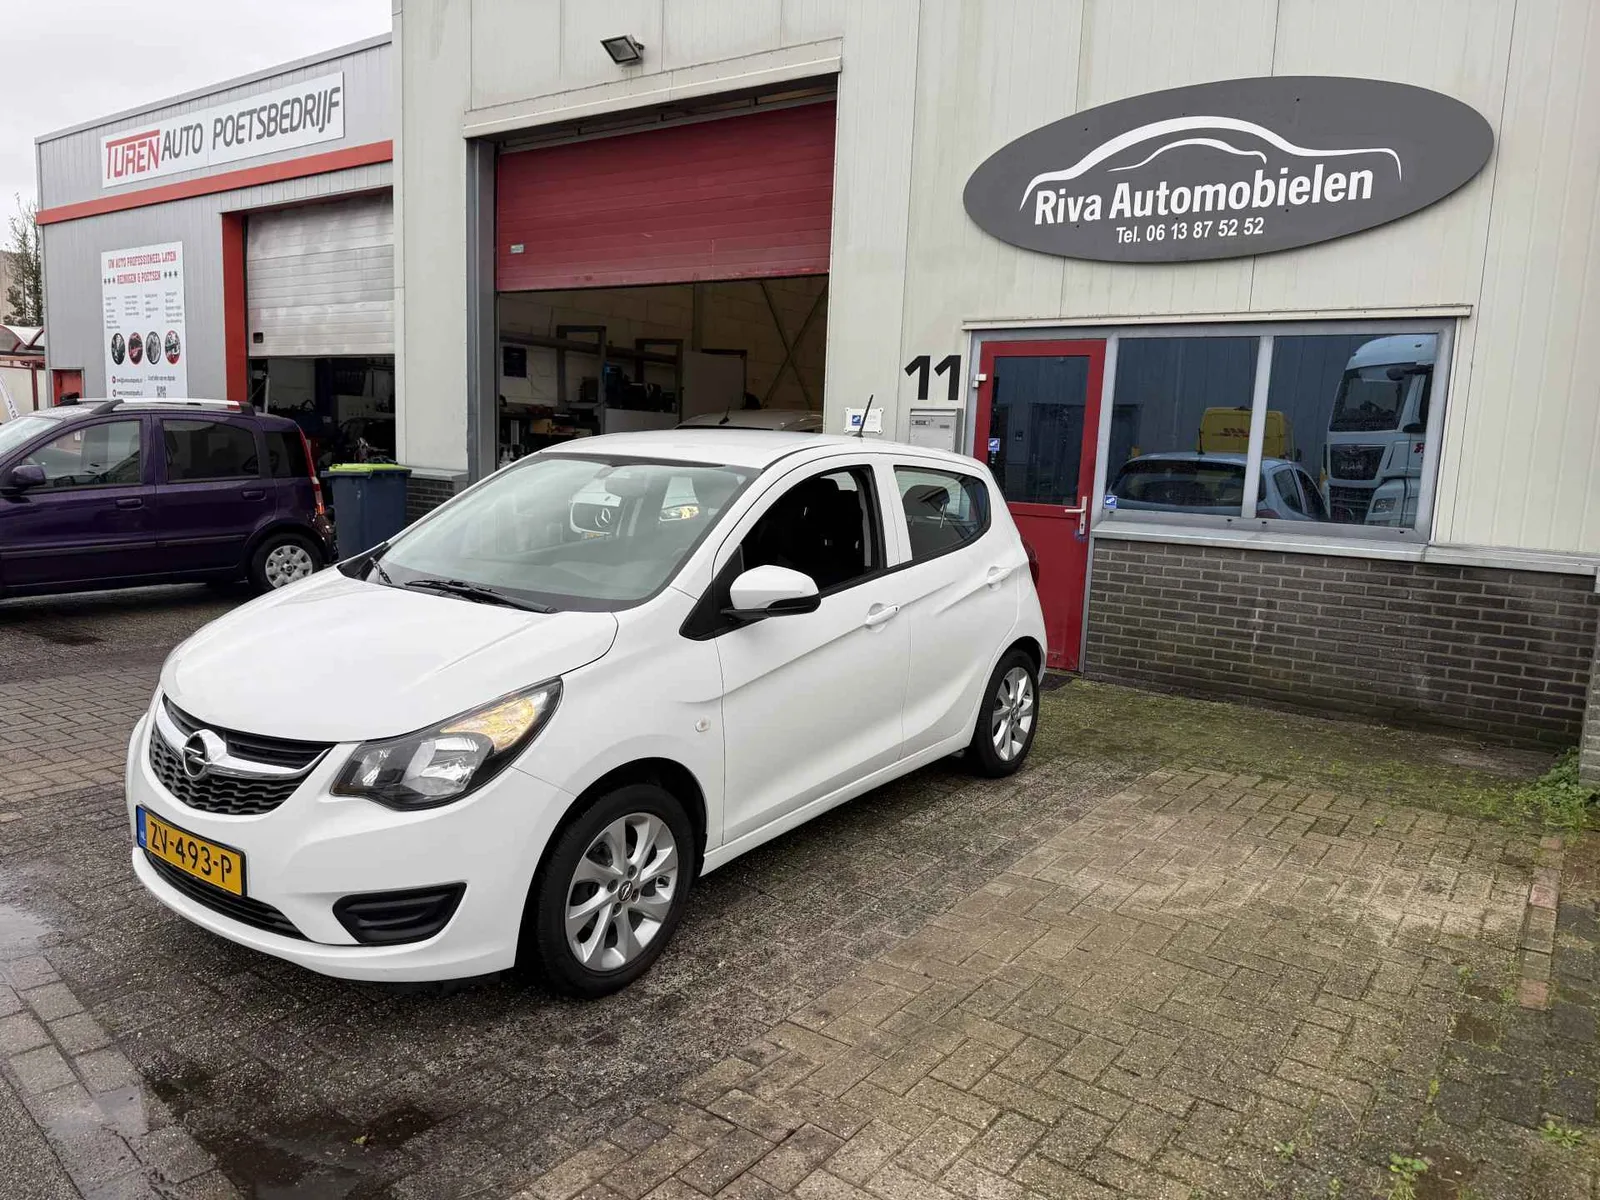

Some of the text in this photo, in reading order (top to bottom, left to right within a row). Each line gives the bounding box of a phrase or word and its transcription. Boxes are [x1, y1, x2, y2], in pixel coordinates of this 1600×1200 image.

[106, 86, 341, 180] TUREN AUTO POETSBEDRIJF
[1034, 164, 1374, 226] Riva Automobielen
[1116, 216, 1265, 244] Tel. 06 13 87 52 52
[127, 252, 161, 267] PROFESSIONEEL
[162, 250, 177, 262] LATEN
[904, 354, 962, 401] 11
[150, 820, 233, 883] ZV-493-P
